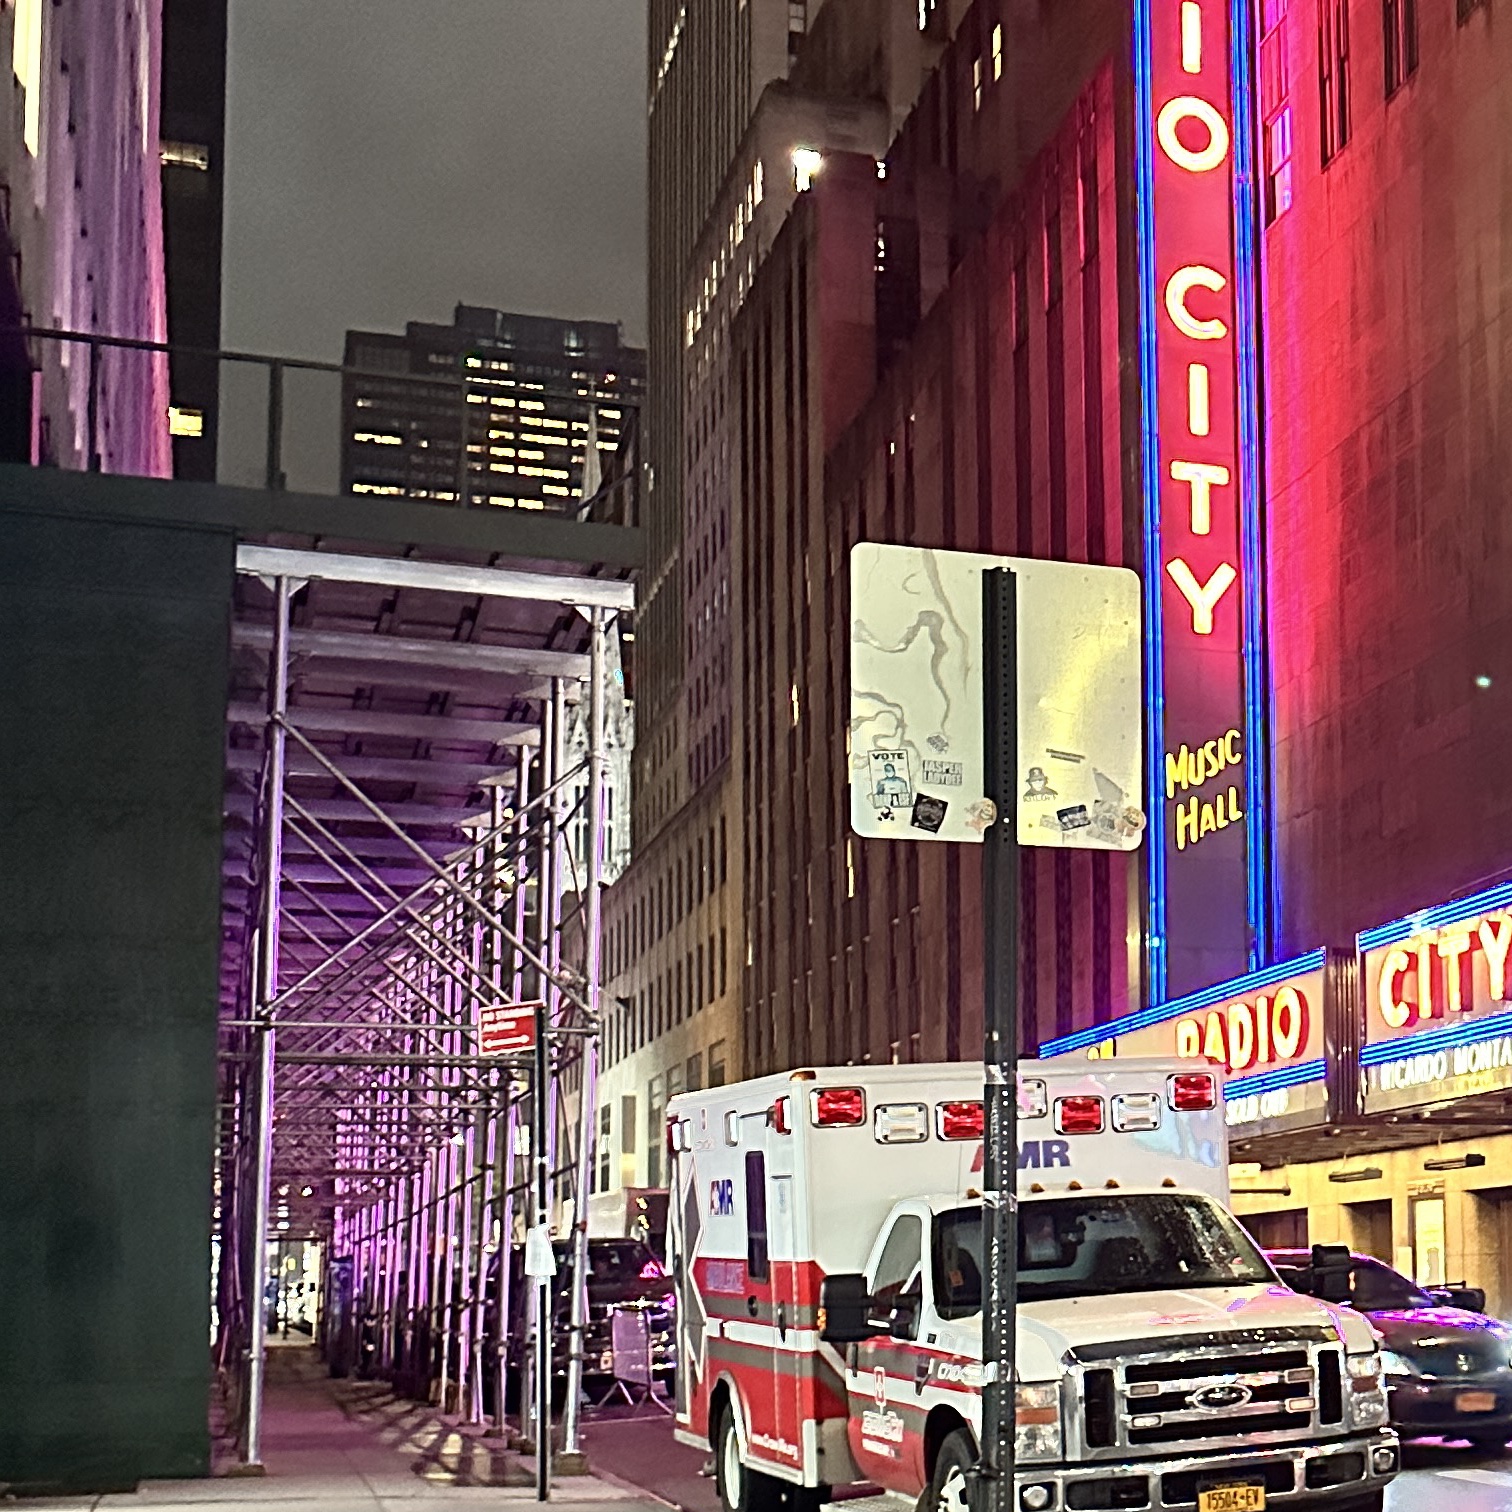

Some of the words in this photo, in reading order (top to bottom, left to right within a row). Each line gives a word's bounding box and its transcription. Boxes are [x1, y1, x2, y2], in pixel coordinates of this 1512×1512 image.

[1164, 264, 1238, 636] CITY
[872, 752, 905, 761] VOTE
[1175, 985, 1305, 1070] RADIO
[1379, 1051, 1447, 1091] RICARDO
